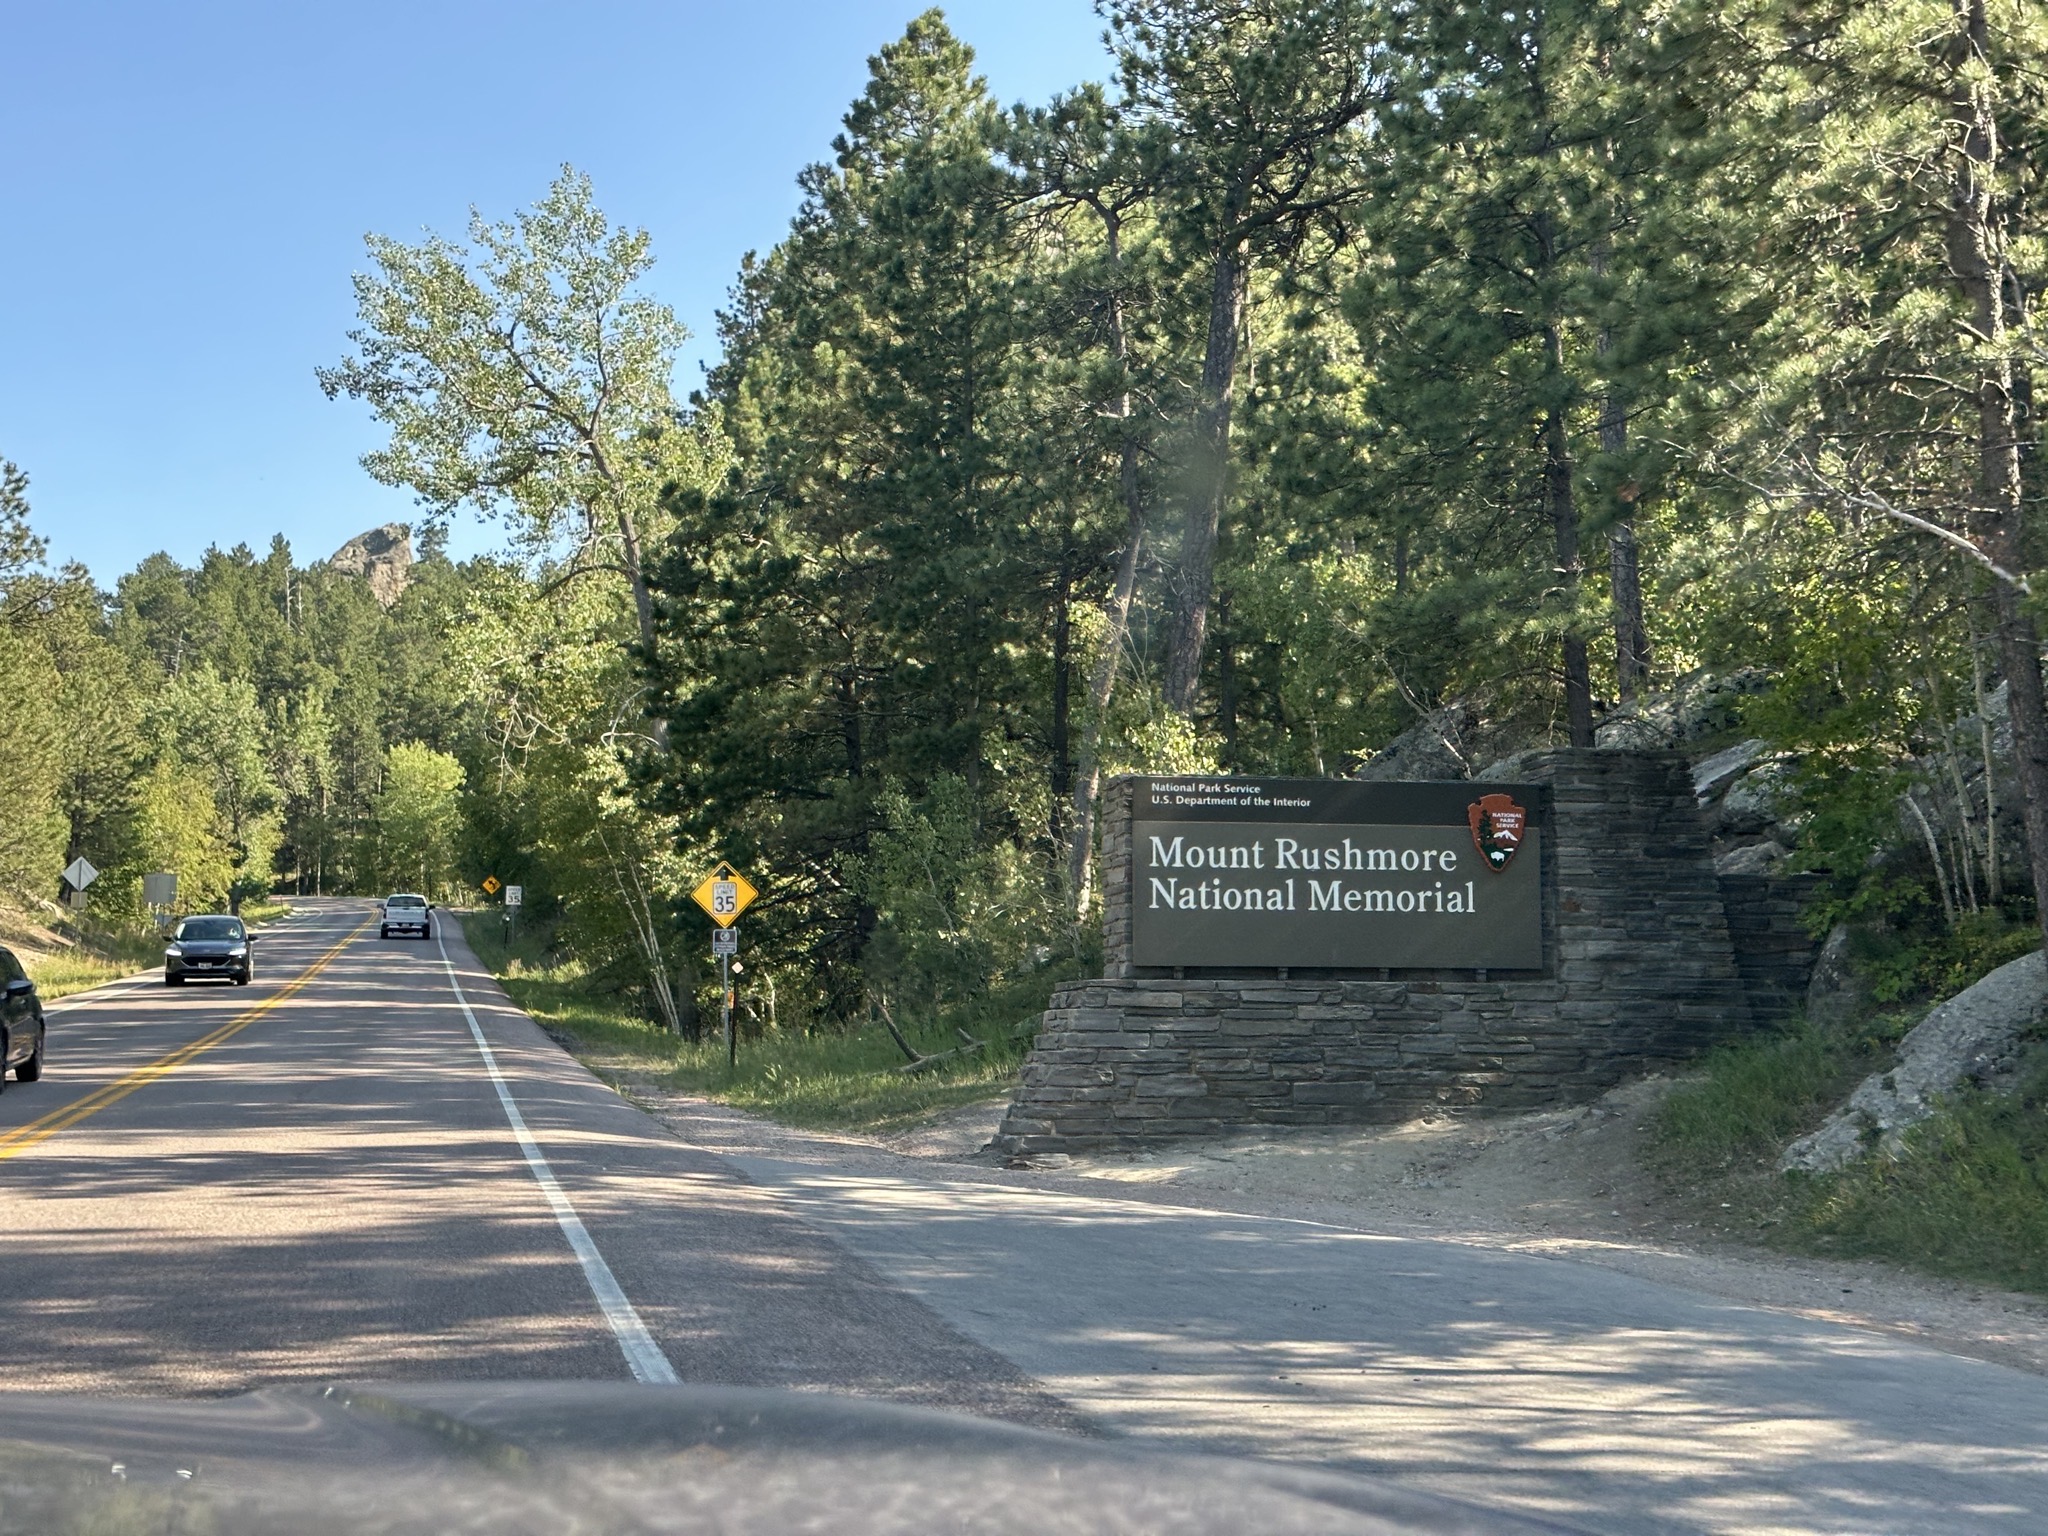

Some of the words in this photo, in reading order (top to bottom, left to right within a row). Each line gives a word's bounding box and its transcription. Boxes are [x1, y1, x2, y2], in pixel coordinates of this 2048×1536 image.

[1151, 782, 1196, 794] National
[1198, 783, 1221, 794] Park
[1223, 784, 1261, 794] Service
[1151, 795, 1172, 805] U.S.
[1175, 796, 1237, 808] Department
[1240, 796, 1252, 807] of
[1254, 797, 1270, 807] the
[1273, 797, 1311, 808] Interior
[1149, 836, 1265, 870] Mount
[1275, 838, 1457, 872] Rushmore
[508, 895, 520, 903] 35
[1149, 877, 1295, 912] National
[1308, 880, 1475, 914] Memorial
[715, 895, 735, 913] 35
